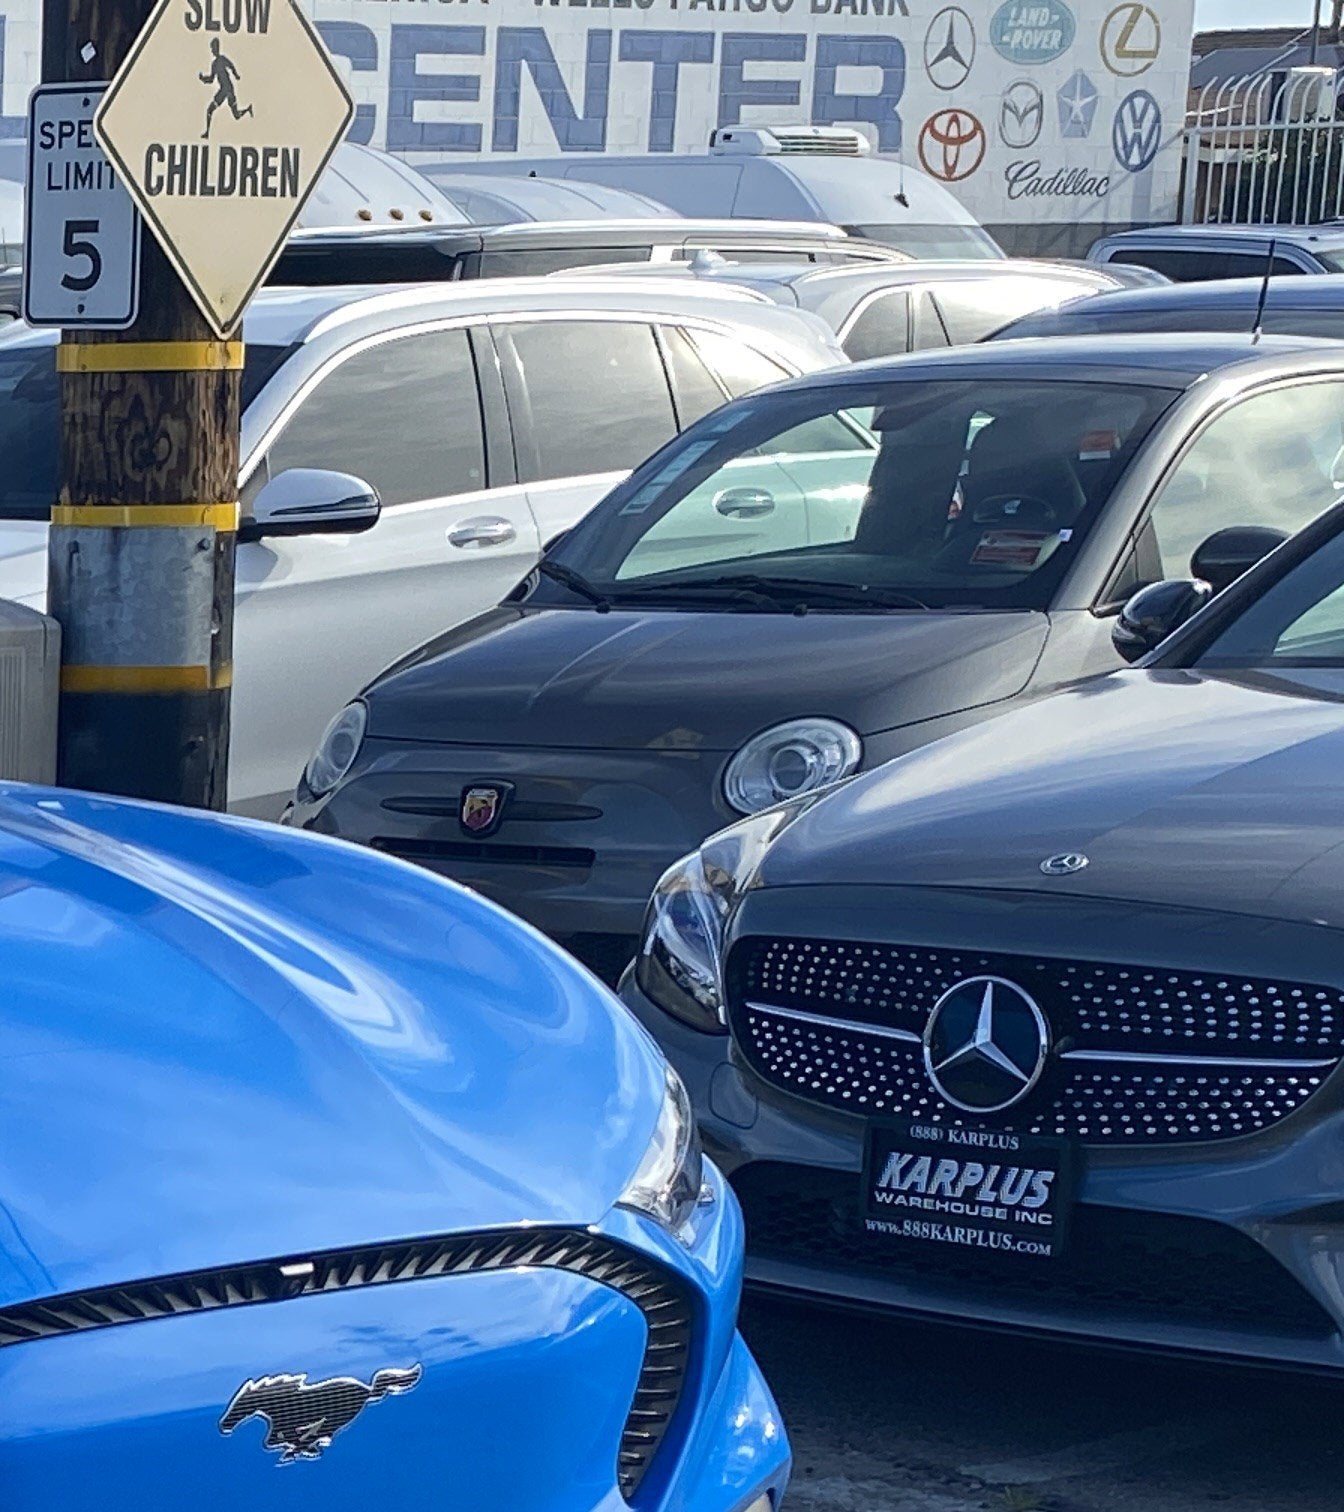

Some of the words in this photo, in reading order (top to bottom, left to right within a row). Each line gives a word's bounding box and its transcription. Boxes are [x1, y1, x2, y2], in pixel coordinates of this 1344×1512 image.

[184, 0, 271, 34] SLOW
[39, 119, 102, 150] SPE
[47, 161, 115, 190] LIMIT
[144, 143, 300, 198] CHILDREN
[1005, 160, 1110, 200] Cadillac
[61, 220, 102, 291] 5
[910, 1126, 944, 1140] (888)
[948, 1129, 1020, 1151] KARPLUS
[877, 1151, 1056, 1209] KARPLUS
[874, 1190, 1008, 1221] WAREHOUSE
[1015, 1209, 1054, 1226] INC
